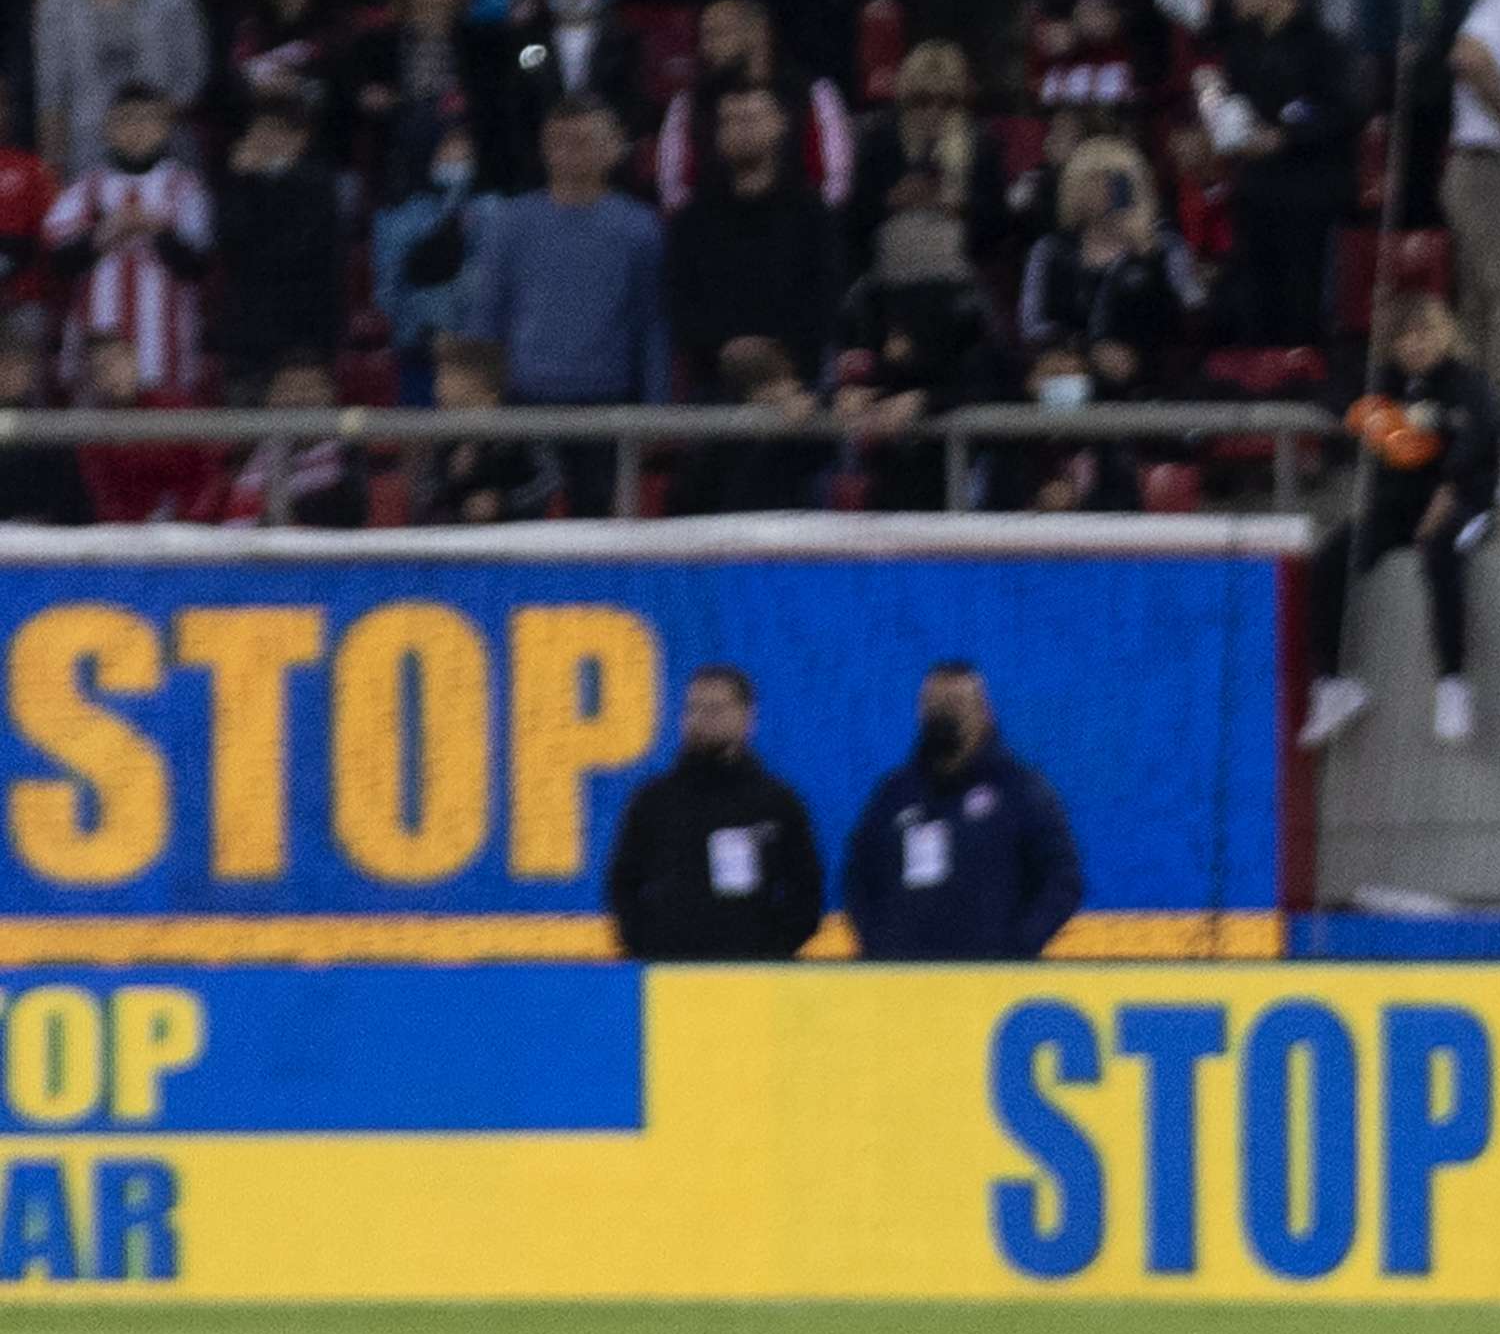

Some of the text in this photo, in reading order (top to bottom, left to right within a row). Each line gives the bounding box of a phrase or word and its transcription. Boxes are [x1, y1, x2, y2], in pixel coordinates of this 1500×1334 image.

[8, 598, 662, 884] STOP
[0, 984, 207, 1124] OP
[985, 994, 1497, 1282] STOP
[0, 1158, 180, 1283] AR
